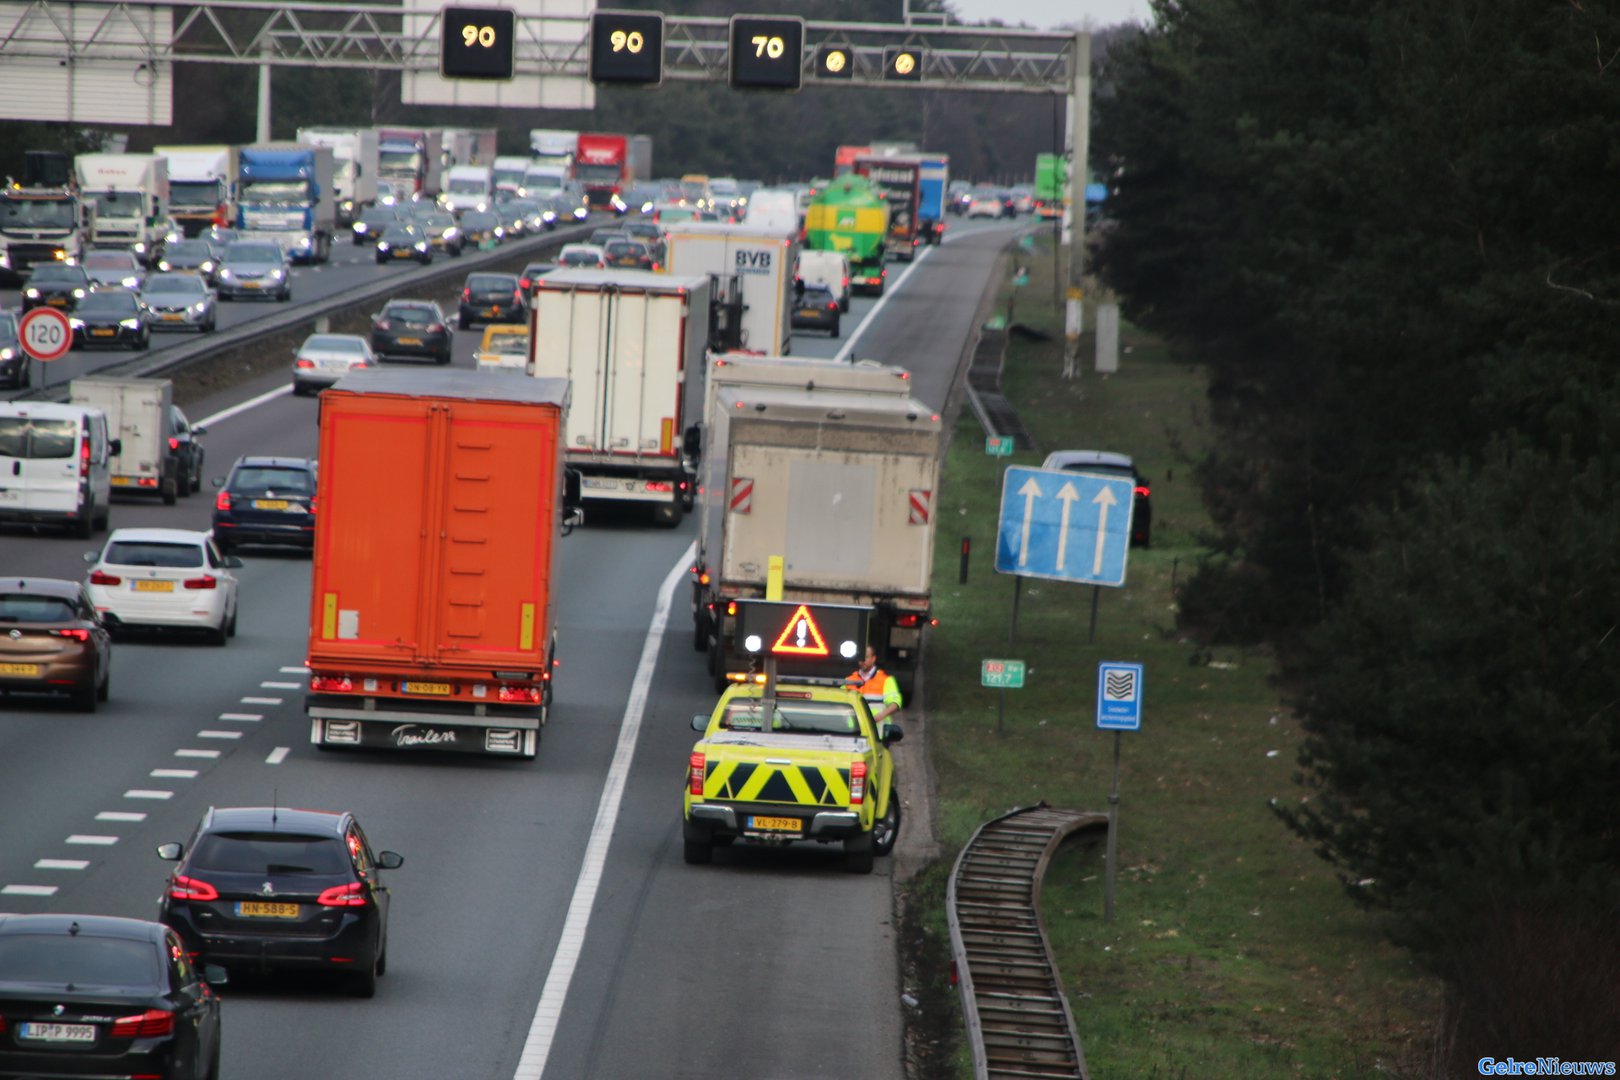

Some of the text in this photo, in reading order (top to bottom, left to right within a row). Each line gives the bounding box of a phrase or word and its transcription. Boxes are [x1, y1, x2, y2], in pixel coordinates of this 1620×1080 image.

[462, 24, 496, 48] 90
[610, 30, 644, 54] 90
[751, 35, 785, 59] 70
[736, 250, 771, 267] BVB
[30, 324, 61, 345] 120
[242, 902, 298, 915] HN-588-S
[65, 1026, 93, 1039] 9995
